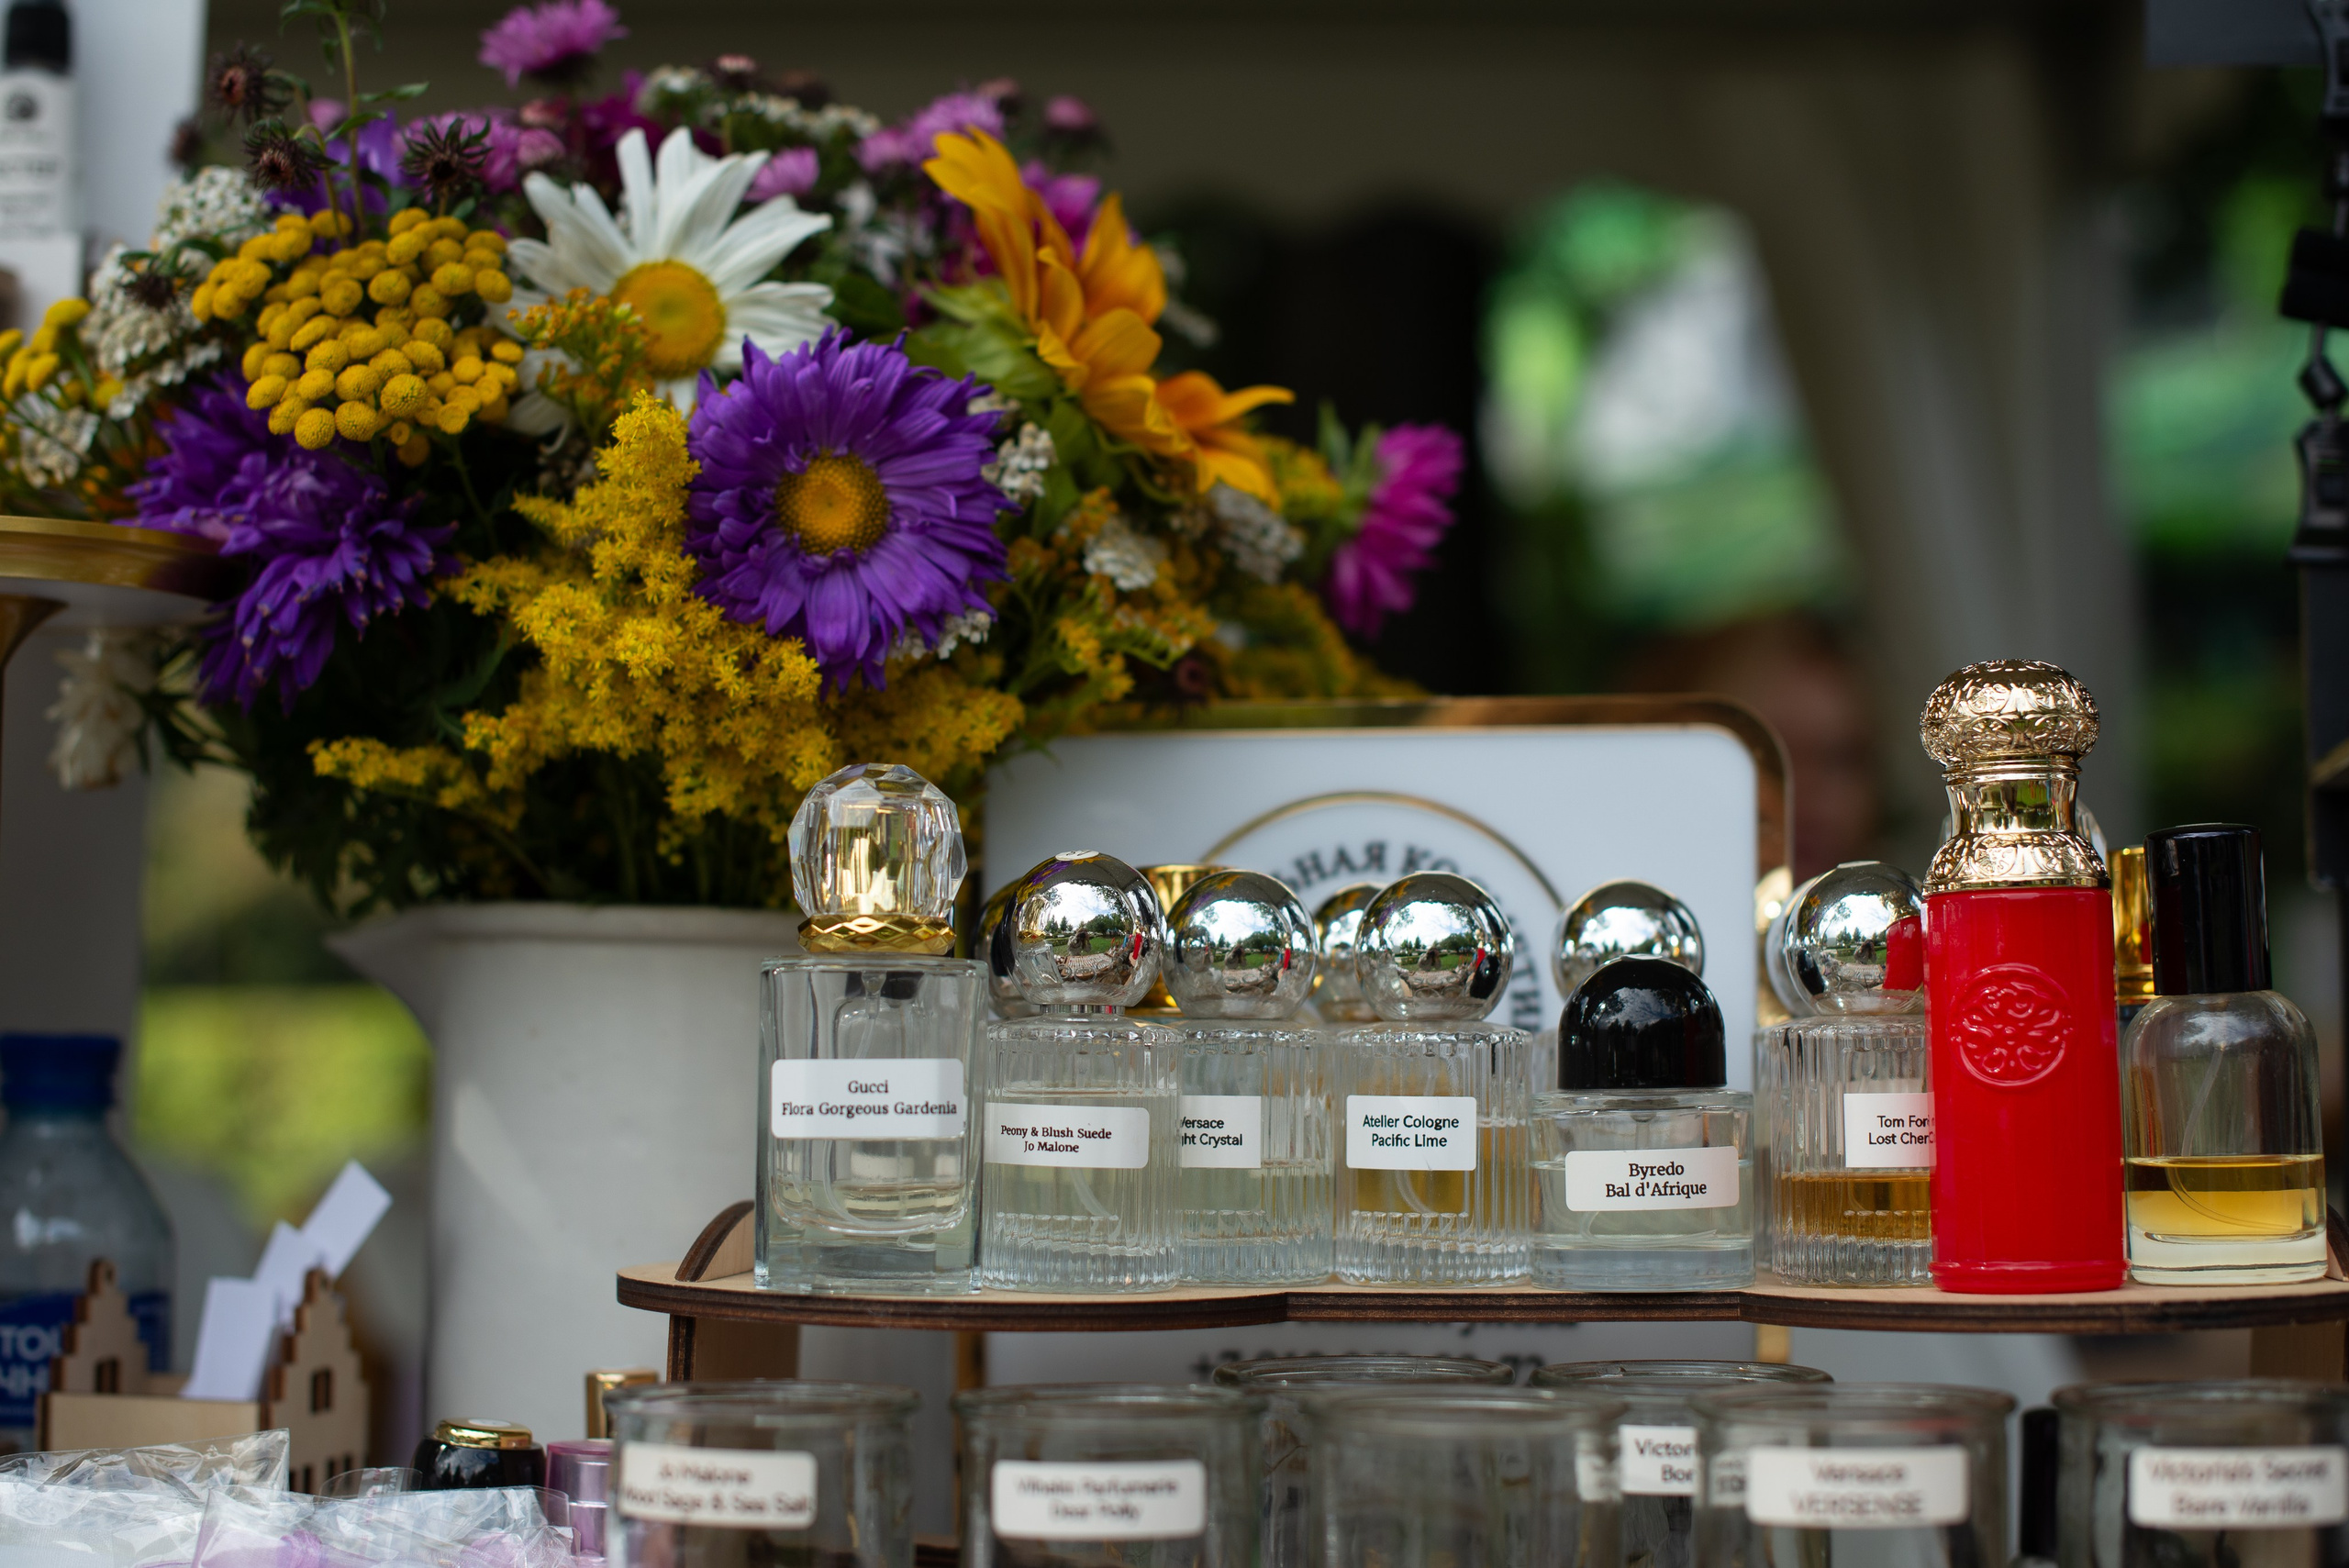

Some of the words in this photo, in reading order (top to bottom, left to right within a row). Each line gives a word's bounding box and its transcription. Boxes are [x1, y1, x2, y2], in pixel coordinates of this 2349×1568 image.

[847, 1079, 889, 1095] Gucci
[781, 1101, 814, 1116] Flora
[818, 1101, 890, 1119] Gorgeous
[894, 1100, 958, 1116] Gardenia
[1362, 1114, 1399, 1129] Atelier
[1402, 1115, 1460, 1131] Cologne
[1876, 1115, 1905, 1129] Tom
[1909, 1115, 1930, 1129] For
[1000, 1124, 1029, 1140] Peony
[1030, 1127, 1039, 1138] &
[1041, 1126, 1074, 1139] Blush
[1077, 1128, 1113, 1140] Suede
[1371, 1132, 1411, 1147] Pacific
[1414, 1133, 1448, 1148] Lime
[1868, 1132, 1897, 1145] Lost
[1023, 1140, 1035, 1153] Jo
[1037, 1140, 1080, 1153] Malone
[1199, 1132, 1243, 1149] Crystal
[1628, 1161, 1685, 1180] Byredo
[1605, 1182, 1631, 1198] Bal
[1634, 1181, 1708, 1199] d'Afrique
